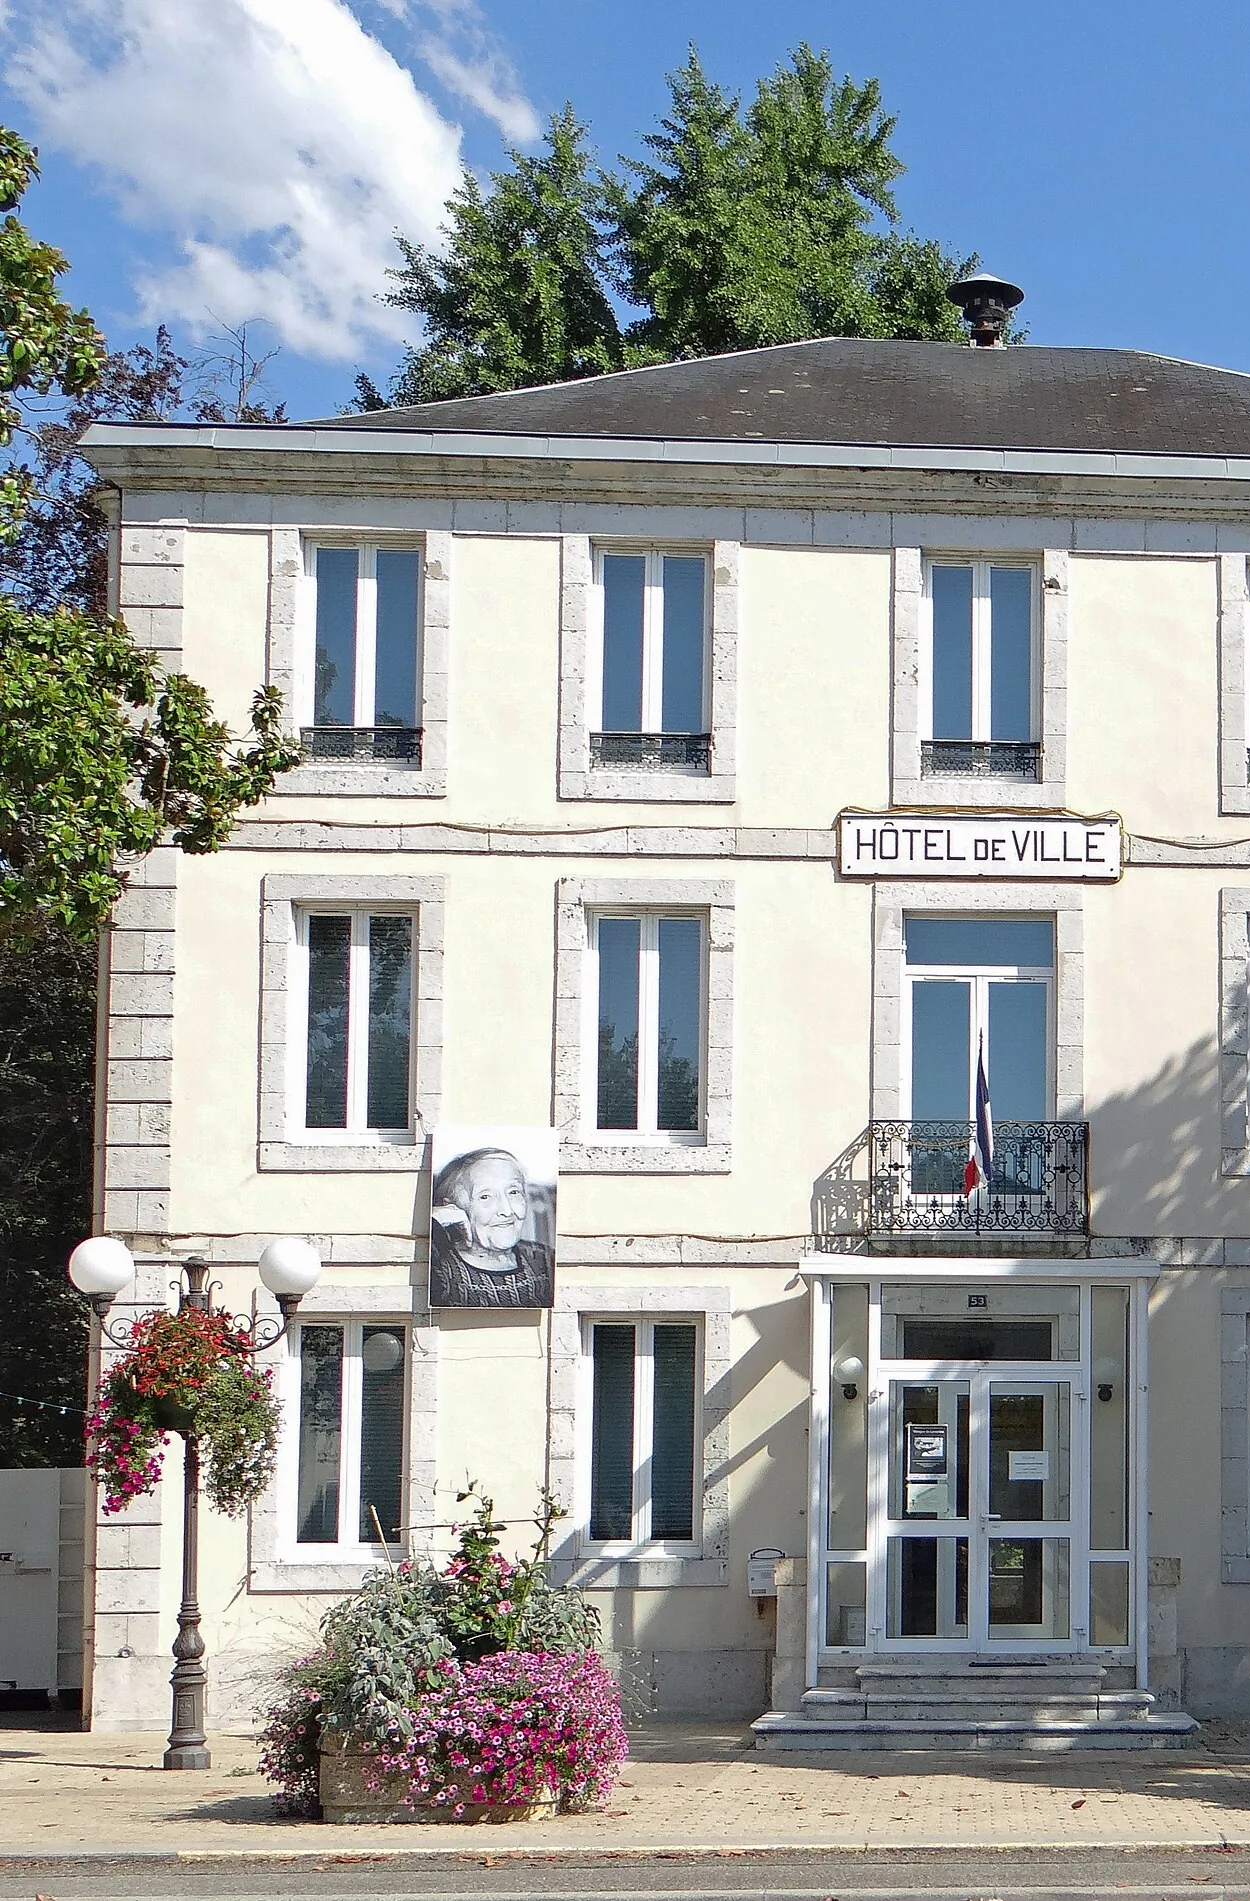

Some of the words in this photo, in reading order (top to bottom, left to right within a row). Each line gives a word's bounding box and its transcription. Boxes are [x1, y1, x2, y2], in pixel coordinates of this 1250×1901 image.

[856, 821, 966, 861] HÔTEL
[974, 839, 1006, 861] DE
[1011, 830, 1105, 862] VILLE
[970, 1296, 985, 1306] 53
